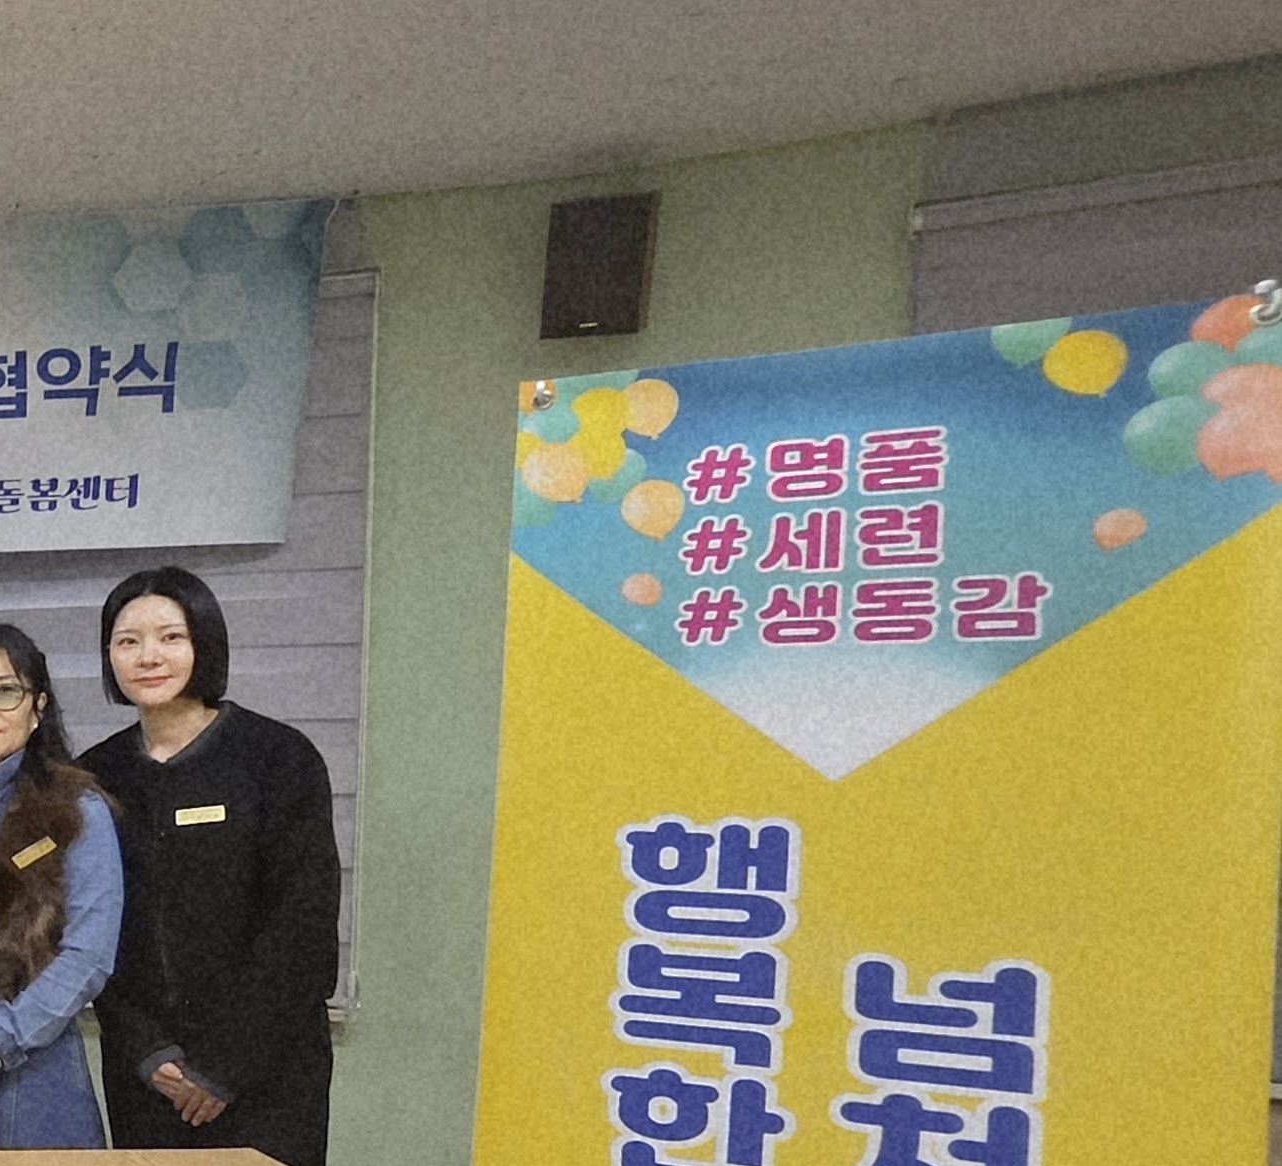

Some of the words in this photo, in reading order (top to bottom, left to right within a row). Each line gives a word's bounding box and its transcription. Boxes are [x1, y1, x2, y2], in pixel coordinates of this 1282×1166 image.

[686, 427, 948, 503] #명품
[682, 504, 944, 573] #세련
[679, 573, 1049, 644] #생동감
